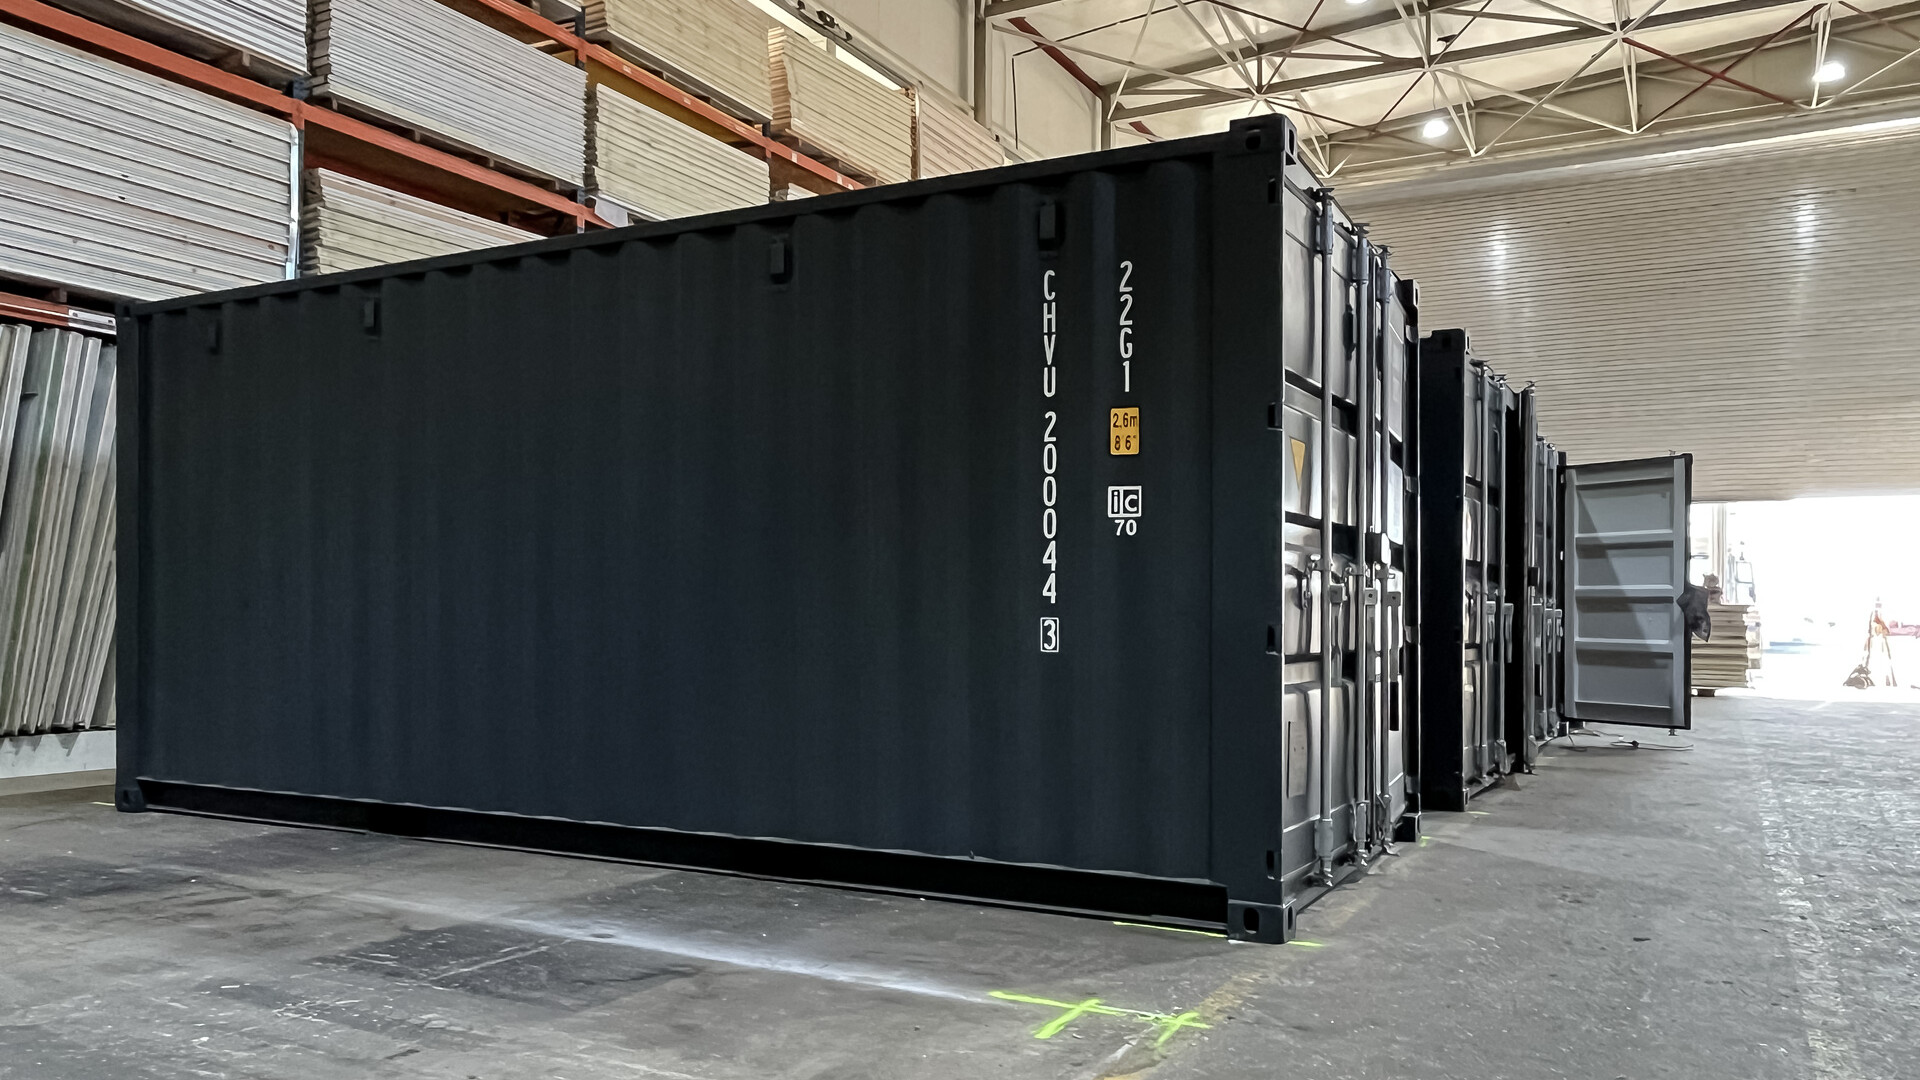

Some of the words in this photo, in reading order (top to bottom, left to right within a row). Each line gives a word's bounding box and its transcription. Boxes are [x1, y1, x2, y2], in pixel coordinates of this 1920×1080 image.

[1043, 269, 1057, 398] CHVU
[1119, 260, 1133, 393] 22G1
[1042, 410, 1058, 604] 200044
[1114, 518, 1137, 537] 70
[1043, 620, 1057, 649] 3
